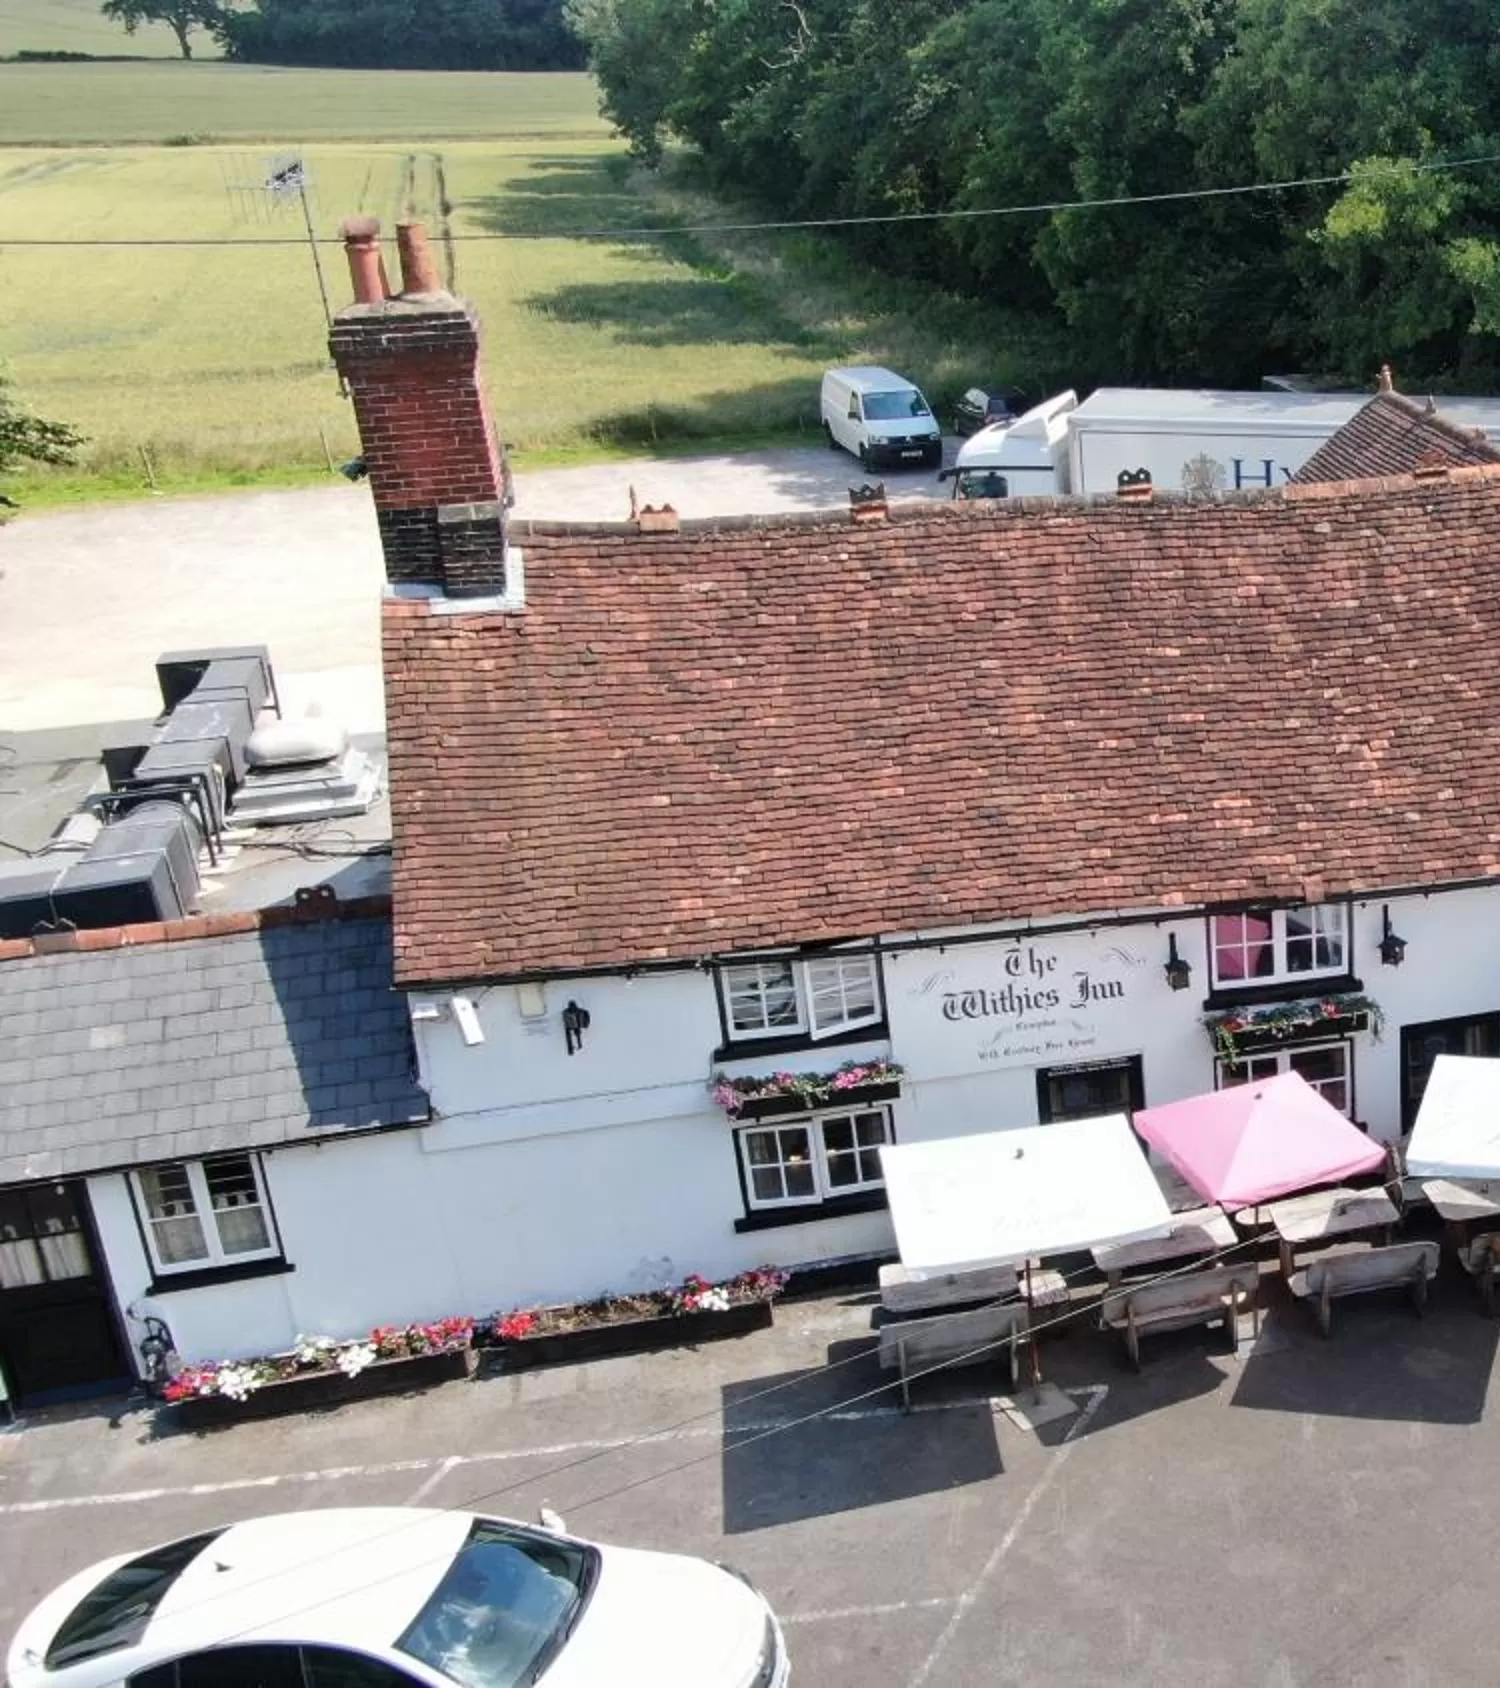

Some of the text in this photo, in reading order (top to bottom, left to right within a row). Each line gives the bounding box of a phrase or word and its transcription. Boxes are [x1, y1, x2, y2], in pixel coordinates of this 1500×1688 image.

[1004, 947, 1057, 980] The
[942, 971, 1125, 1021] Withies Inn
